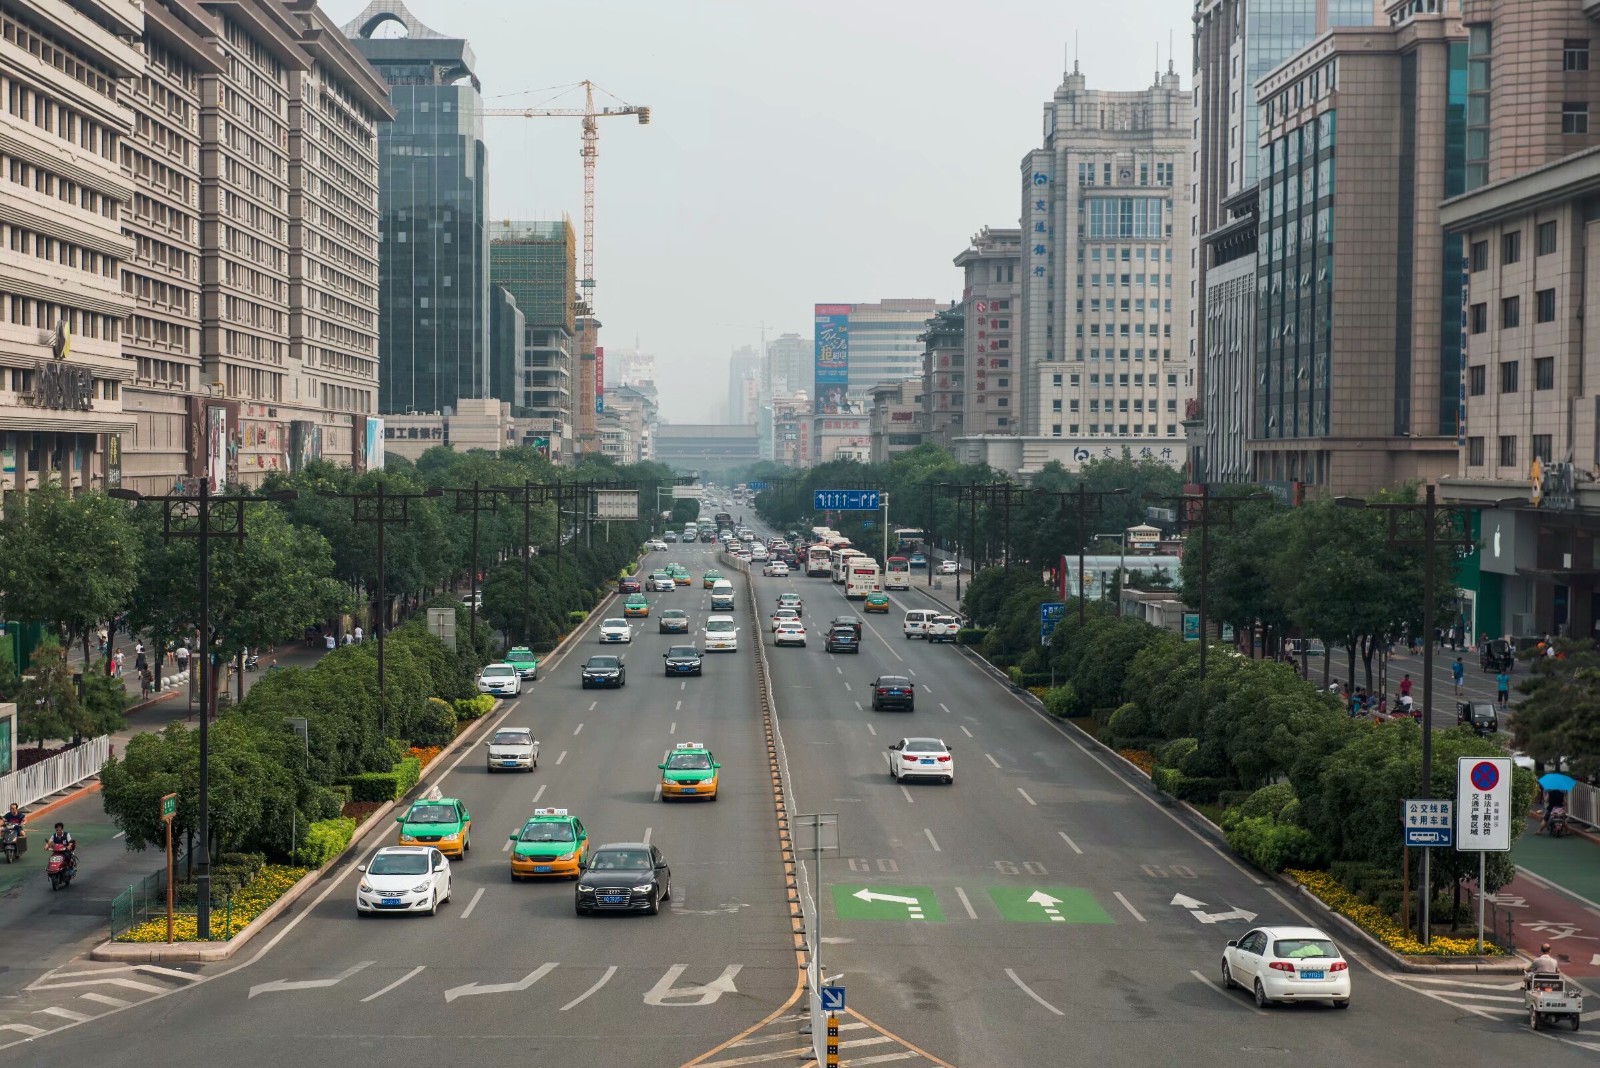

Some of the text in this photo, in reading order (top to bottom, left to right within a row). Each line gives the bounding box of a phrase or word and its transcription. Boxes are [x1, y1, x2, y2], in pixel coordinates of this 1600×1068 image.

[1033, 199, 1047, 278] 交通银行
[990, 301, 999, 369] 招商银行
[1102, 446, 1172, 459] 交银行
[1410, 803, 1449, 813] 公交线路
[1470, 793, 1480, 836] 交通严管区域
[1410, 815, 1449, 826] 专用车道
[994, 860, 1049, 875] 60
[1139, 863, 1199, 879] 60
